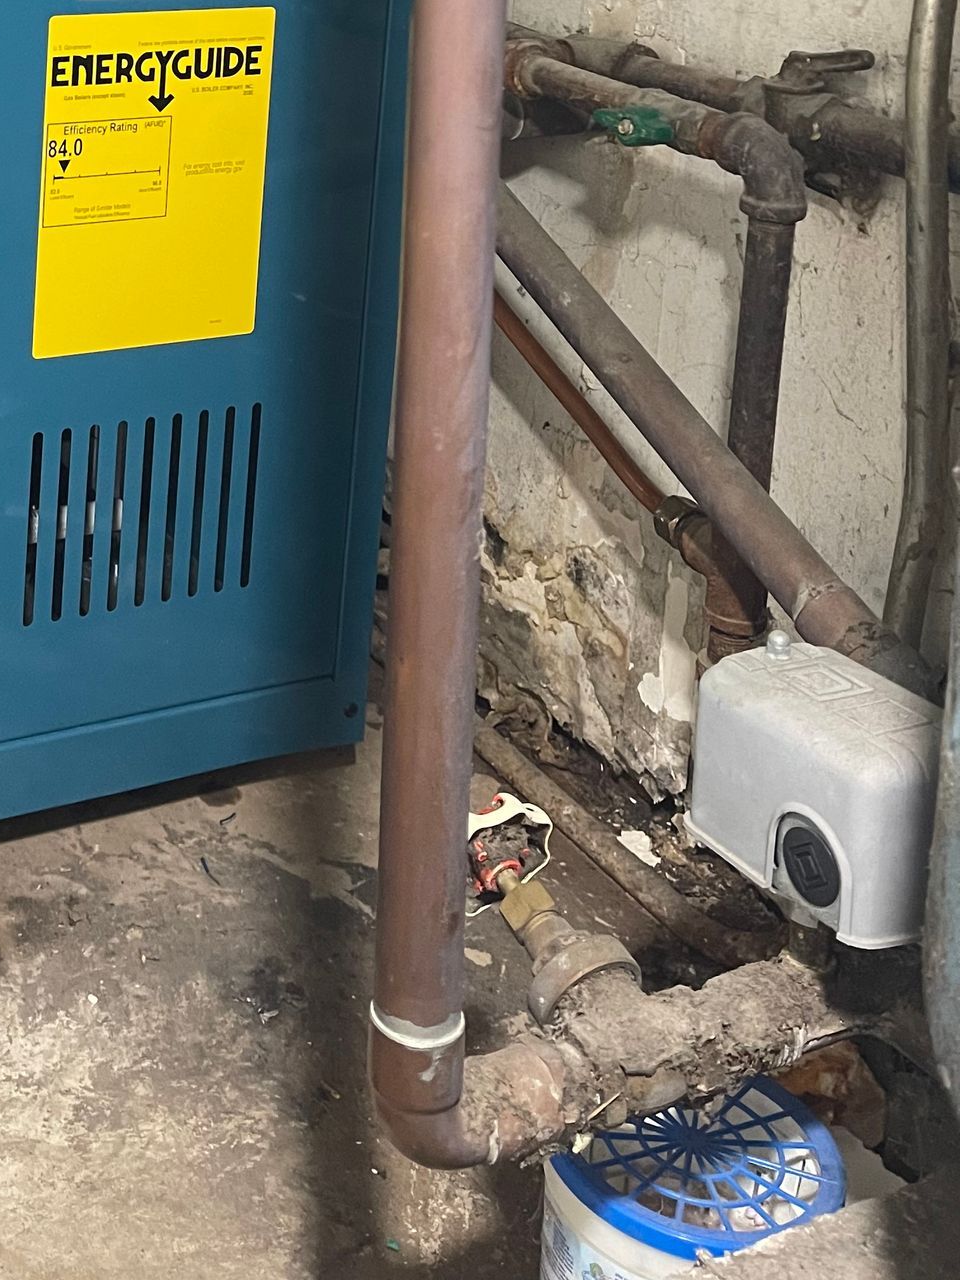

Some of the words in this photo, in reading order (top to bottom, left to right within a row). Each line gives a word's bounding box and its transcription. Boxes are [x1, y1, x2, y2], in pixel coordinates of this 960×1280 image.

[51, 45, 262, 87] ENERGYGUIDE
[63, 125, 107, 136] Efficiency
[110, 122, 138, 133] Rating
[48, 138, 83, 158] 84.0
